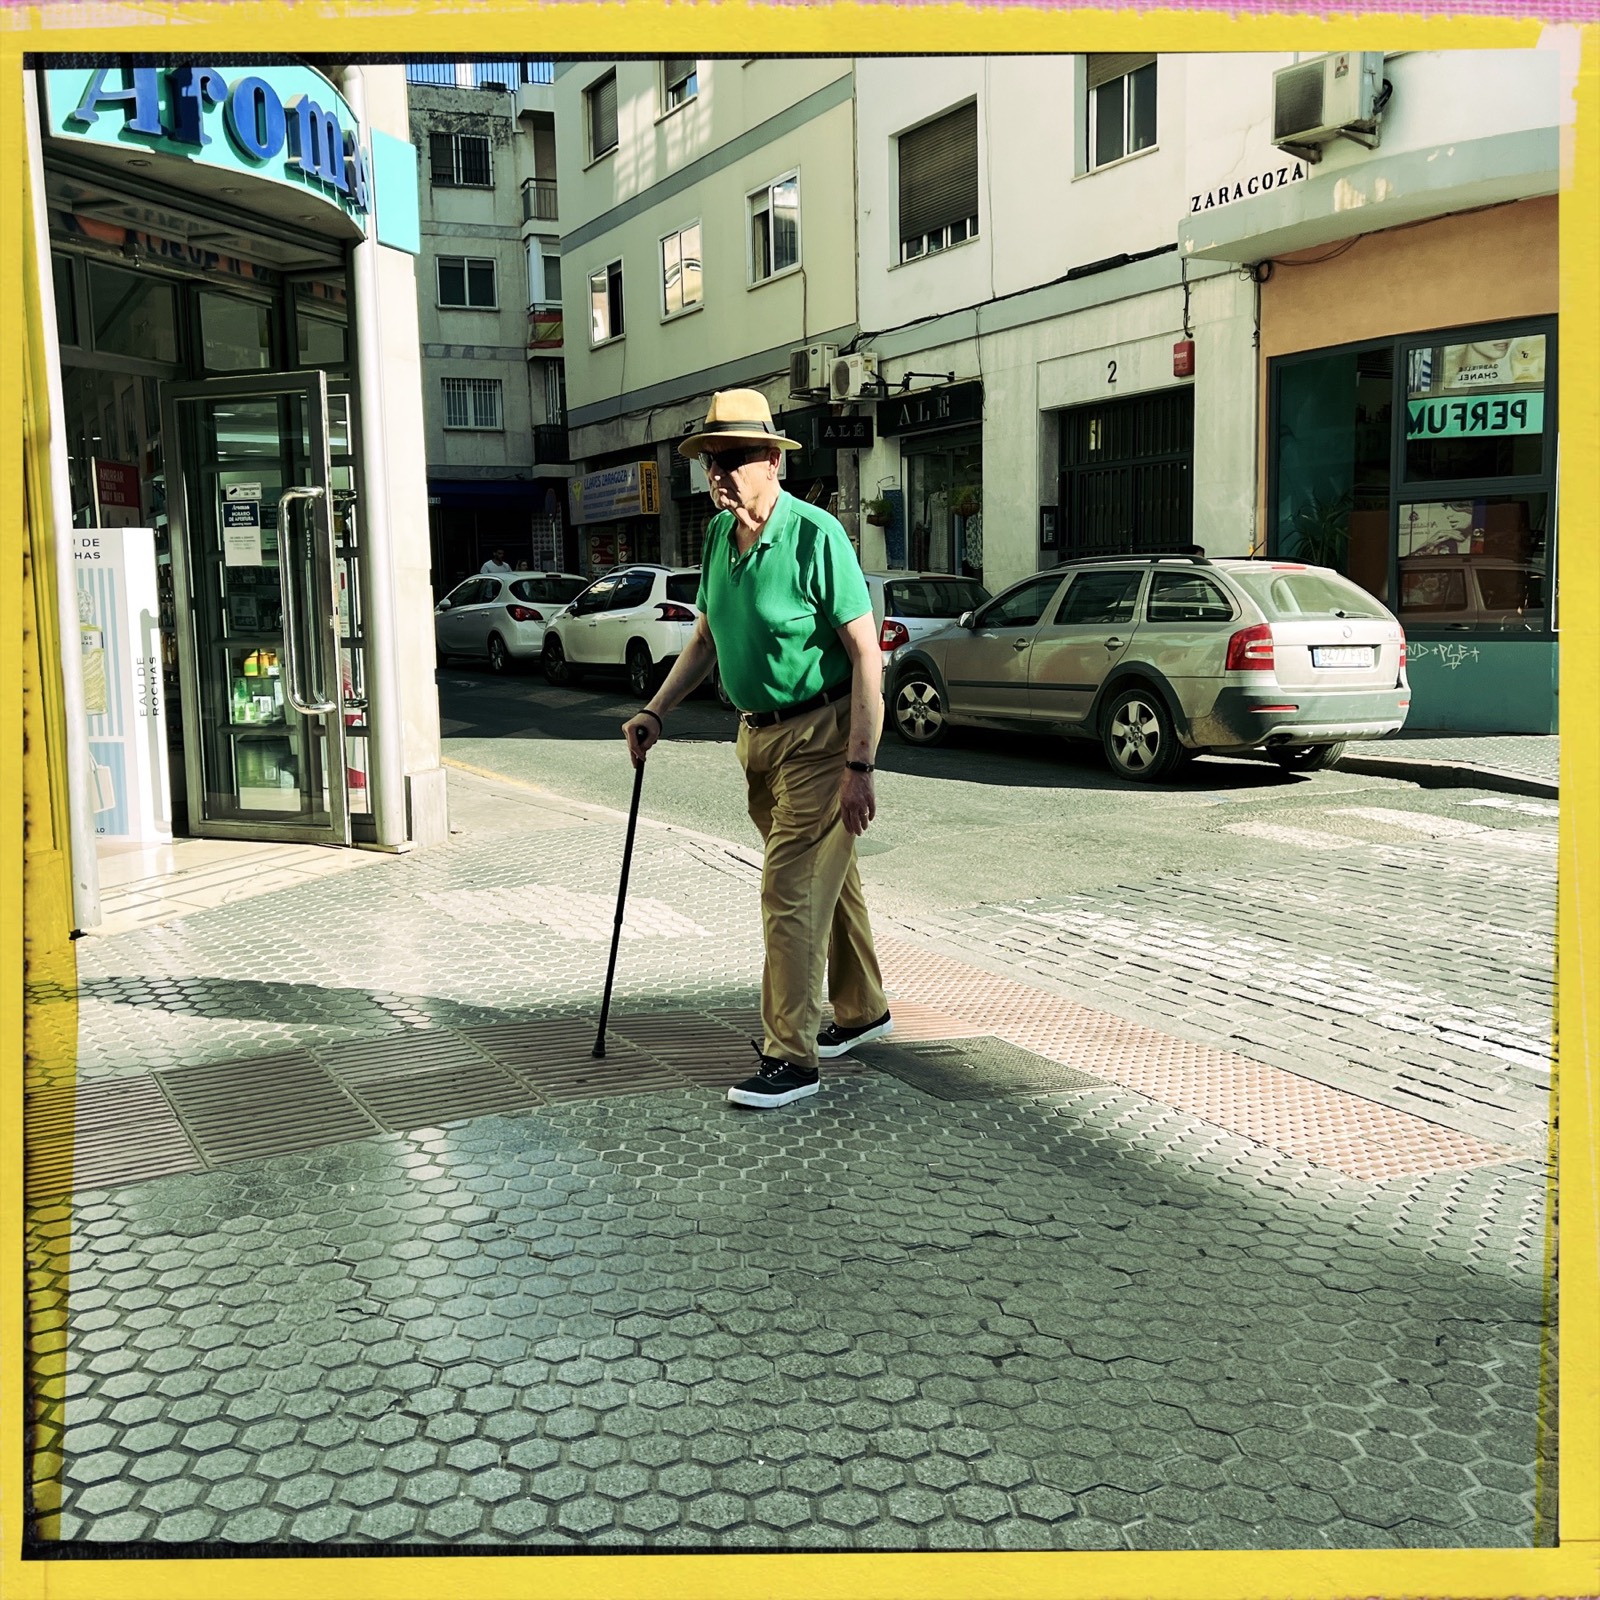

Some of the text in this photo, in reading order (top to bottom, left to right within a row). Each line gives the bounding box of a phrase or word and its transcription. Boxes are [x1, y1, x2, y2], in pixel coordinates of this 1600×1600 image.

[1191, 162, 1304, 213] ZARAGOZA
[1107, 360, 1117, 383] 2
[82, 538, 100, 547] DE
[136, 657, 148, 717] EAU DE
[149, 656, 159, 717] ROCHAS
